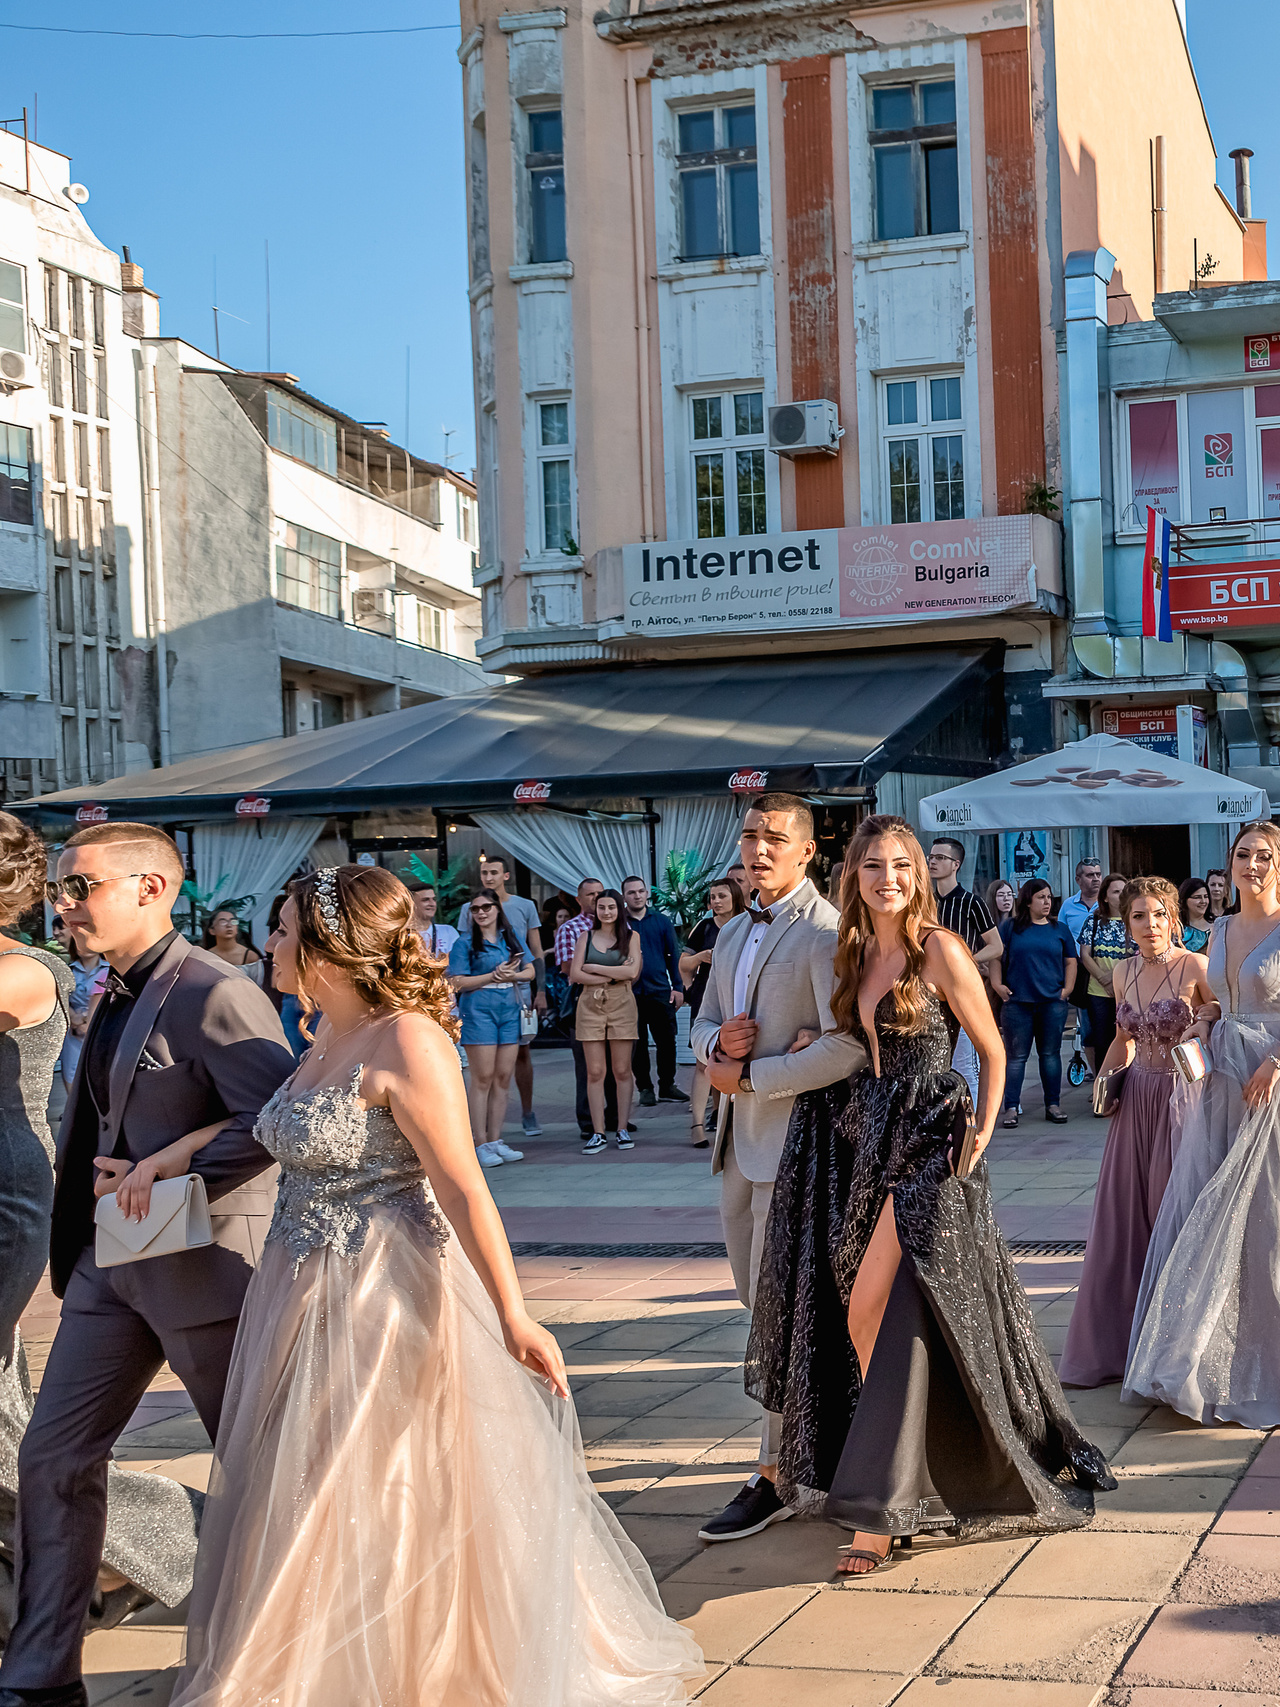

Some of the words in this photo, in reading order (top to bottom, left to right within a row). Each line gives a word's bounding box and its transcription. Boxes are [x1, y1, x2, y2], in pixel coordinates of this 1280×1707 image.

[1251, 359, 1269, 367] БСП
[1205, 466, 1234, 479] БСП
[1135, 486, 1178, 496] СПРАВЕДЛИВОСТ
[852, 534, 899, 552] ComNet
[909, 536, 1003, 561] ComNet
[641, 538, 821, 583] Internet
[848, 564, 905, 578] INTERNET
[914, 562, 990, 584] Bulgaria
[629, 591, 697, 607] Светът
[701, 587, 712, 602] в
[715, 584, 783, 602] твоите
[785, 578, 834, 605] ръце!
[849, 587, 903, 607] BULGARIA
[1209, 576, 1270, 605] БСП
[904, 600, 923, 609] NEW
[925, 598, 976, 608] GENERATION
[631, 619, 645, 629] гр.
[647, 615, 682, 626] Айтос,
[684, 616, 696, 624] ул.
[759, 611, 766, 619] 5,
[788, 607, 809, 617] 0558/
[810, 606, 834, 615] 22188
[1180, 615, 1229, 625] www.bsp.bg
[1120, 709, 1163, 719] ОБЩИНСКИ
[1140, 721, 1165, 731] БСП
[935, 803, 972, 823] bianchi
[1217, 795, 1252, 813] bianchi
